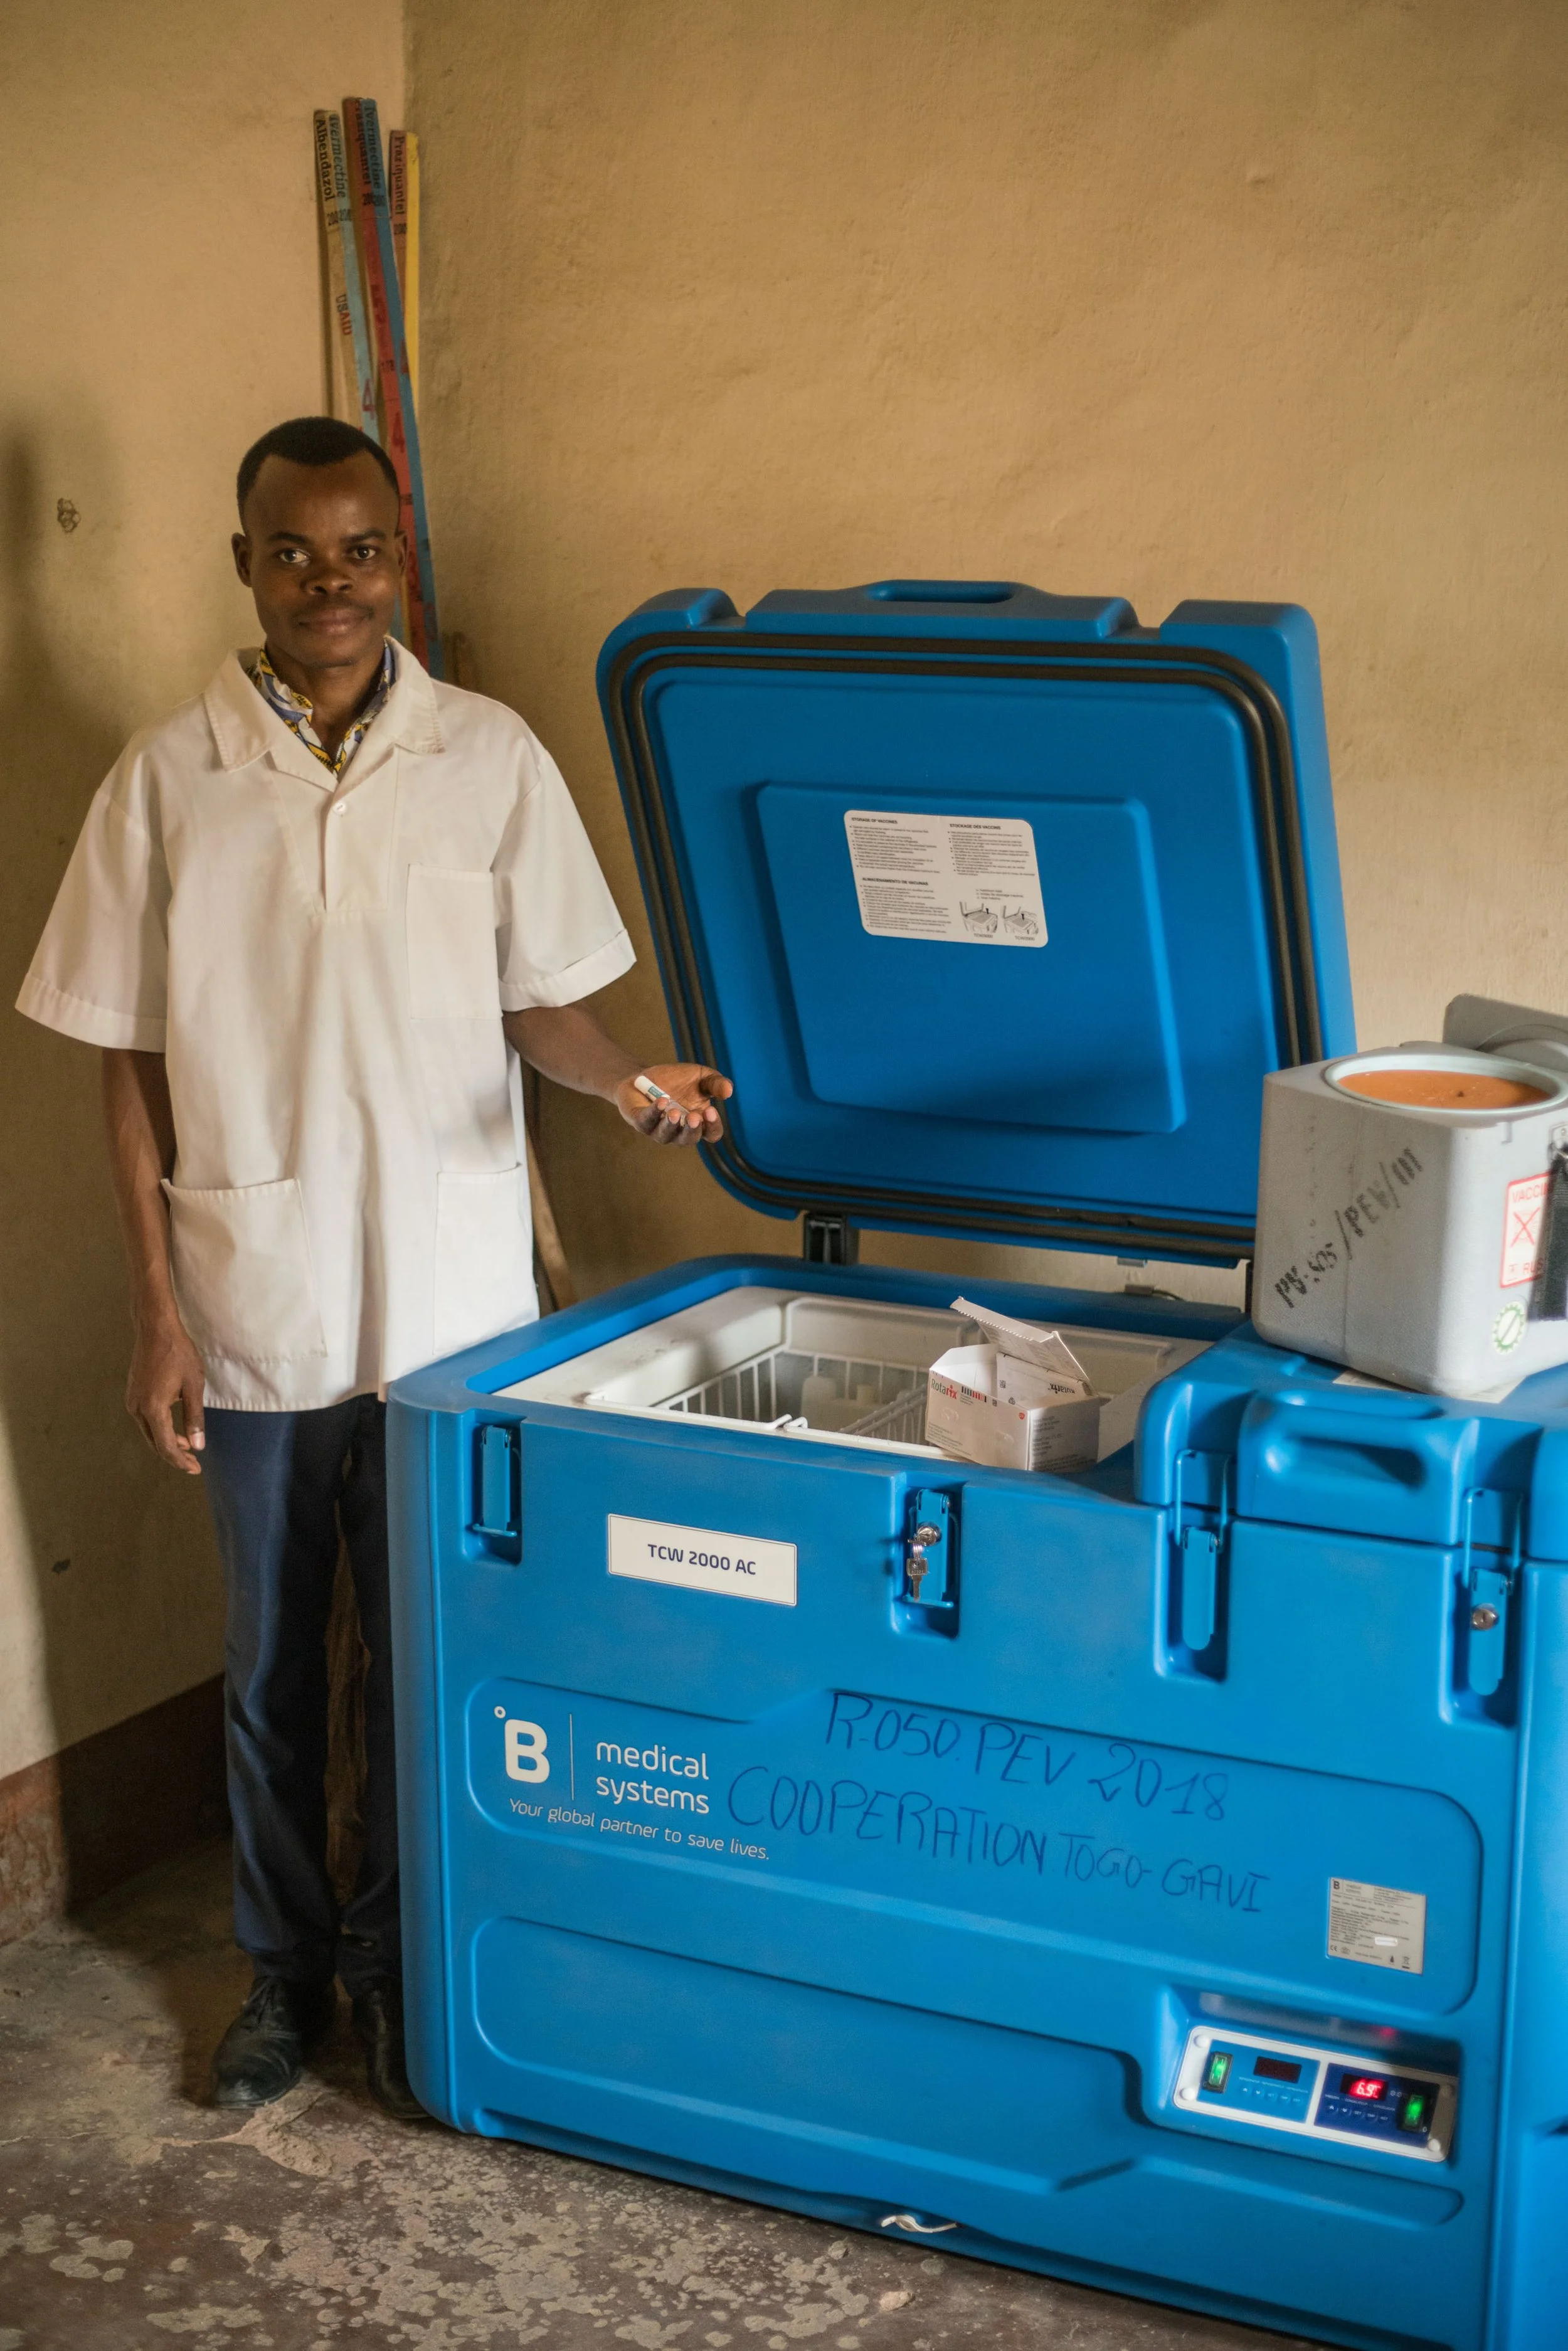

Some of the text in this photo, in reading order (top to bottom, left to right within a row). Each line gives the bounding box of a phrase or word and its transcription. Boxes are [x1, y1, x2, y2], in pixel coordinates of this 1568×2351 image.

[315, 119, 336, 201] Albendazol
[364, 105, 382, 189] Ivermectine
[392, 135, 405, 215] Praziquantel
[336, 294, 352, 336] USAID
[931, 1378, 957, 1401] Rotarix
[647, 1544, 756, 1575] TCW 2000 AC
[595, 1741, 709, 1780] medical
[1088, 1743, 1229, 1820] 2018
[595, 1775, 710, 1814] systems
[728, 1766, 1046, 1876] COOPERATION
[509, 1797, 770, 1861] Your global partner to save lives.
